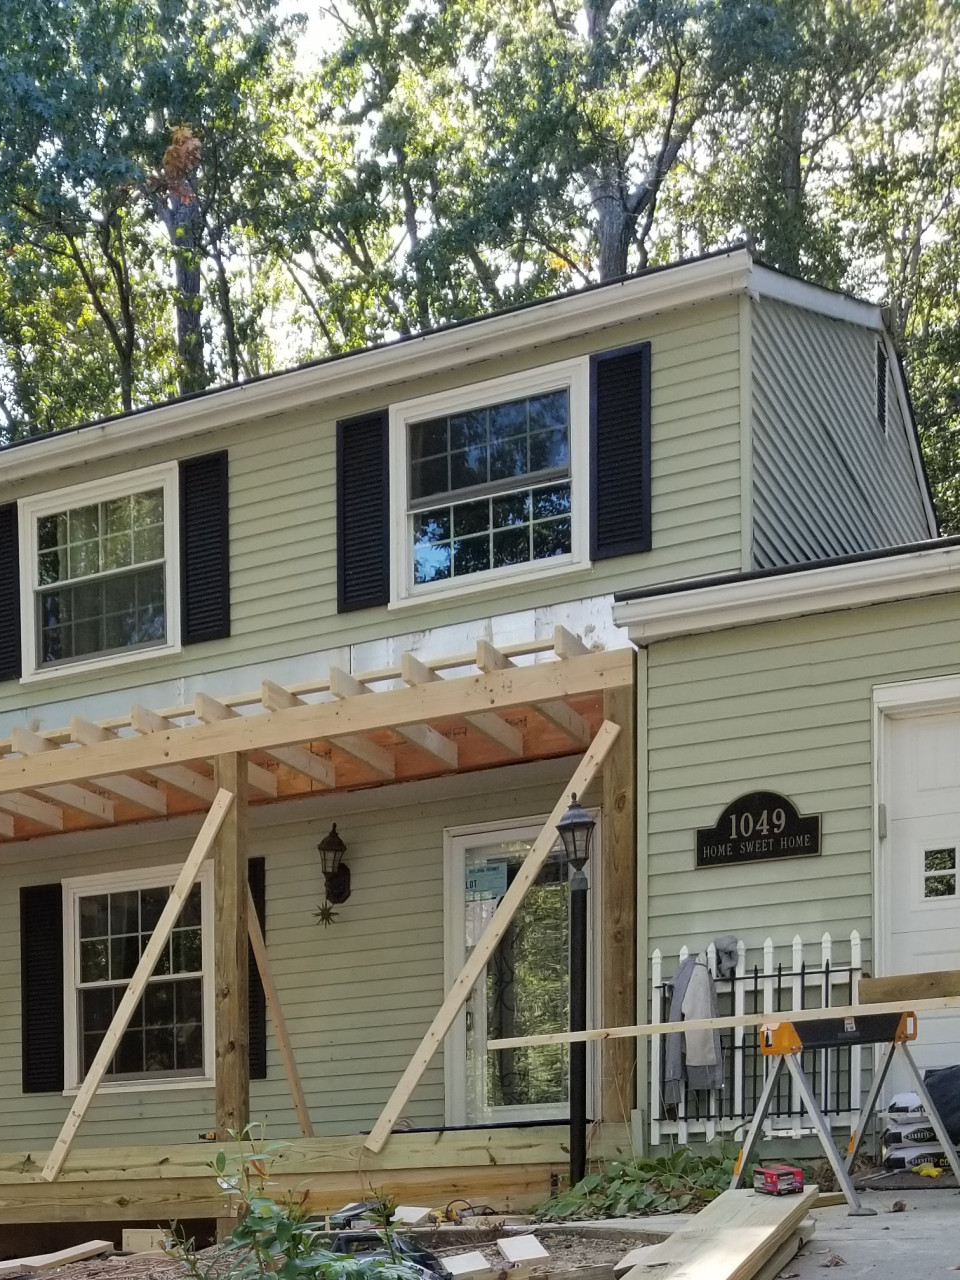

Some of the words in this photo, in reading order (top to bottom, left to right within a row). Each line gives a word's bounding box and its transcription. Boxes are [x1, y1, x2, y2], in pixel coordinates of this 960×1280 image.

[729, 808, 786, 839] 1049
[703, 843, 733, 858] HOME
[739, 838, 774, 854] SWEET
[780, 834, 811, 849] HOME
